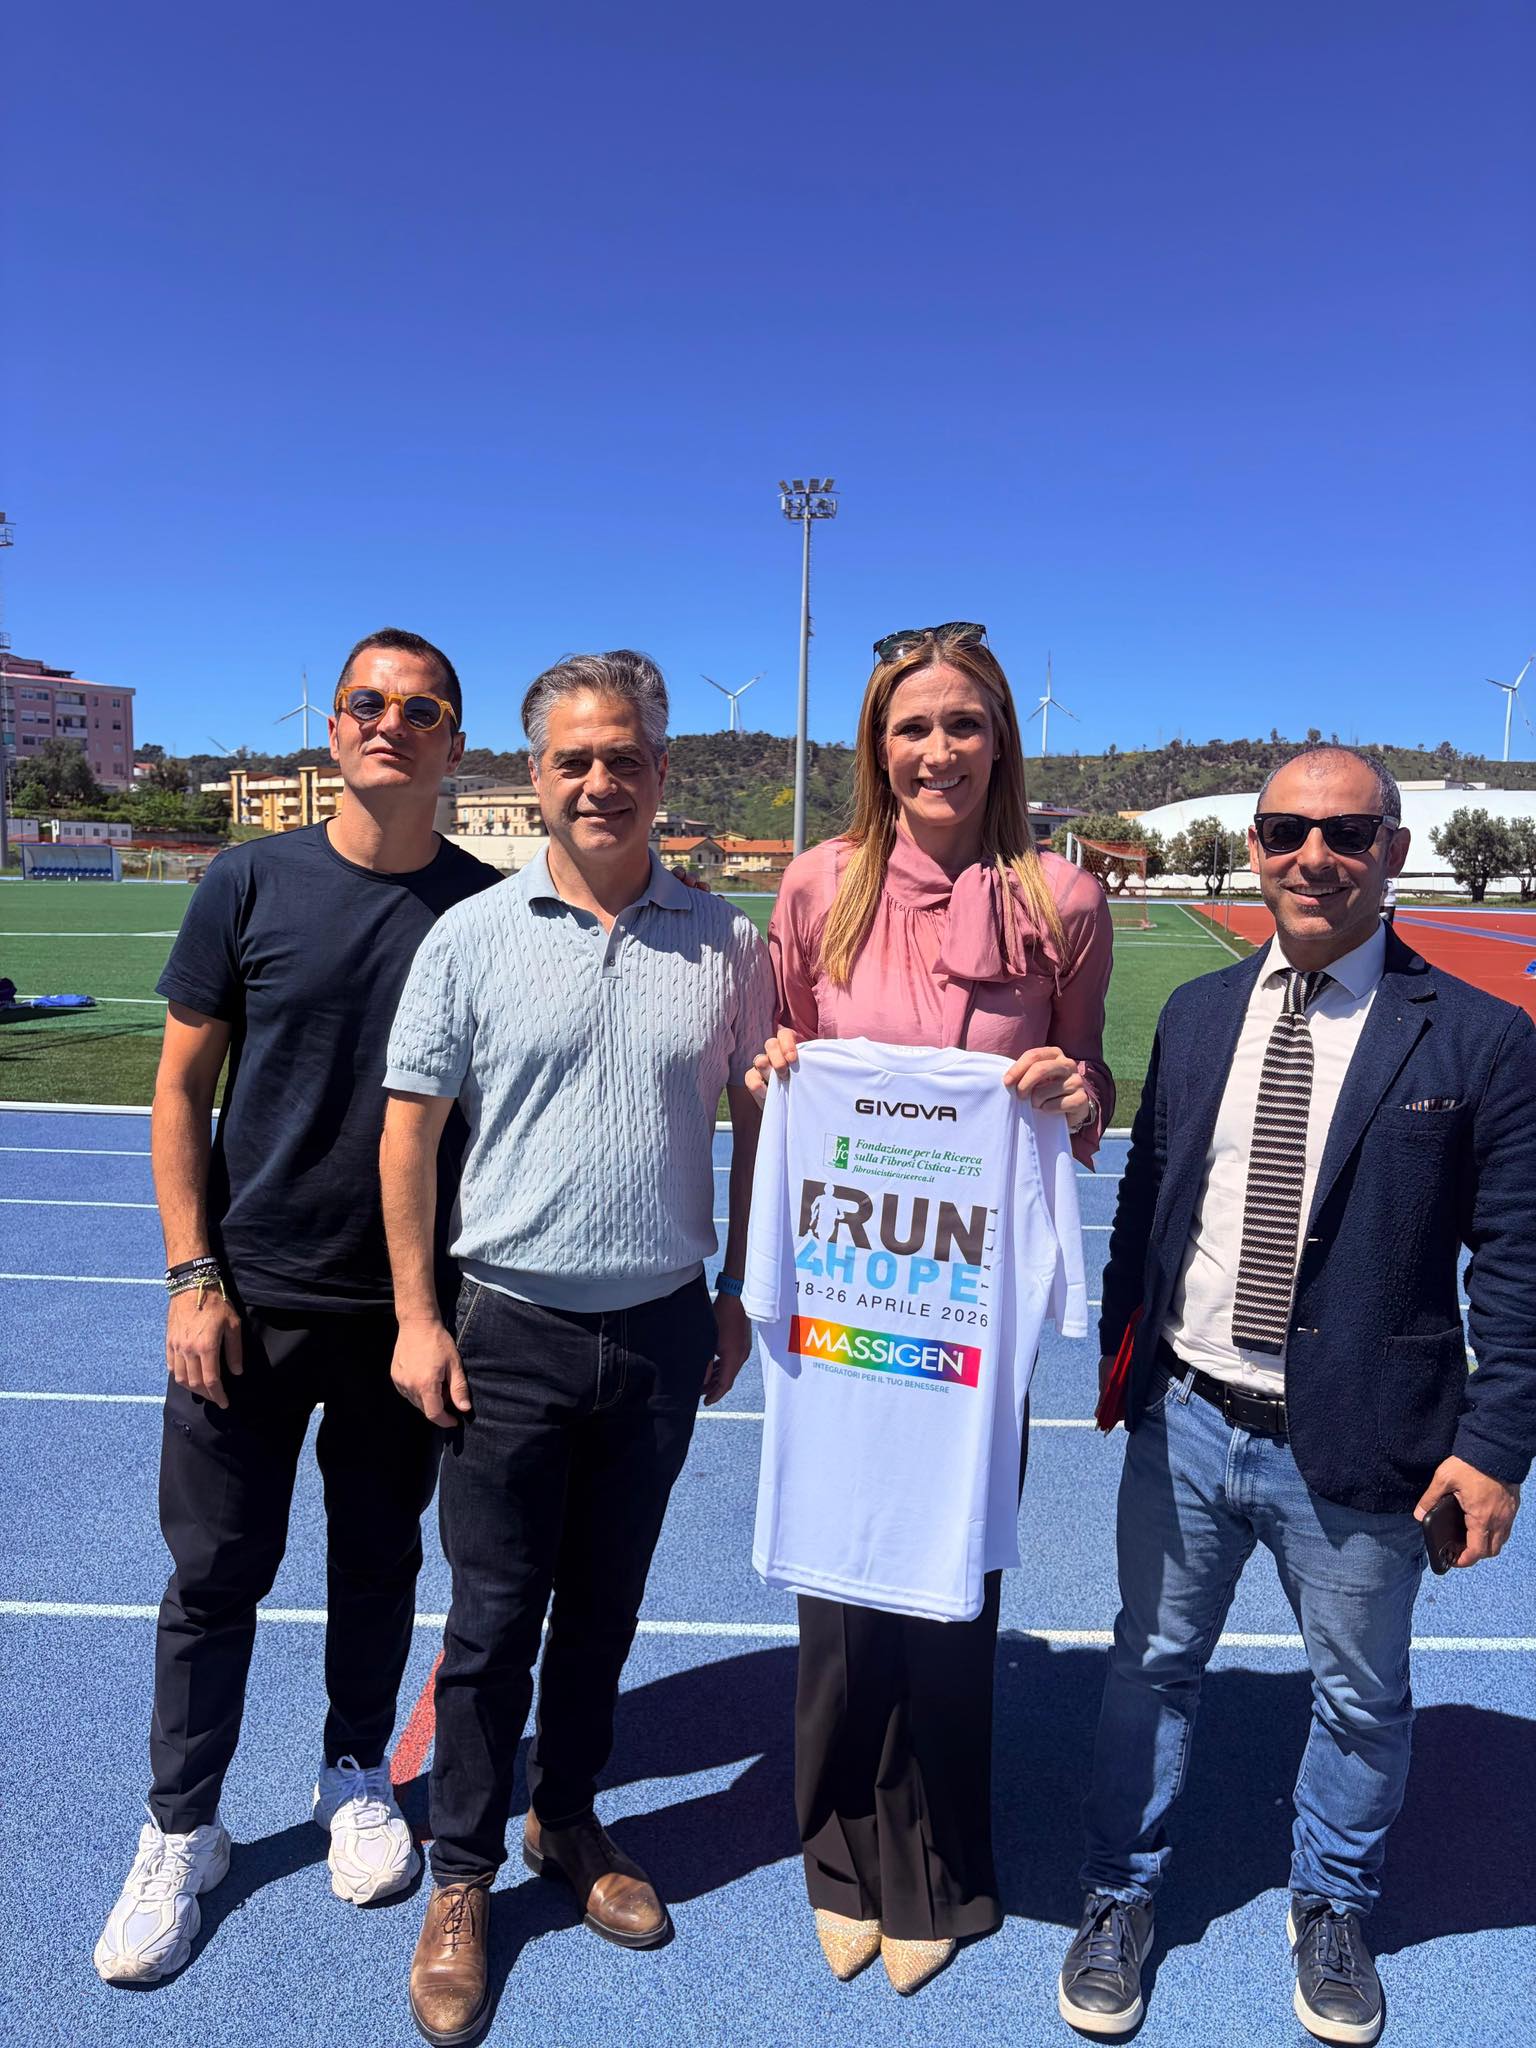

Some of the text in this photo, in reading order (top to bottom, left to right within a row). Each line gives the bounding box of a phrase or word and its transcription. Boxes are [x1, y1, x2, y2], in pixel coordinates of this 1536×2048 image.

[855, 1099, 957, 1122] GIVOVA
[853, 1153, 879, 1164] sulla
[880, 1155, 916, 1169] Fibrosi
[855, 1138, 983, 1166] Fondazione per la Ricerca
[799, 1179, 988, 1267] RUN
[796, 1239, 982, 1304] 4HOPE
[979, 1208, 999, 1307] ITALIA
[795, 1281, 989, 1328] 18-26 APRILE 2026
[805, 1324, 965, 1377] MASSIGEN
[812, 1361, 951, 1395] INTEGRATORI PER IL TUO BENESSERE
